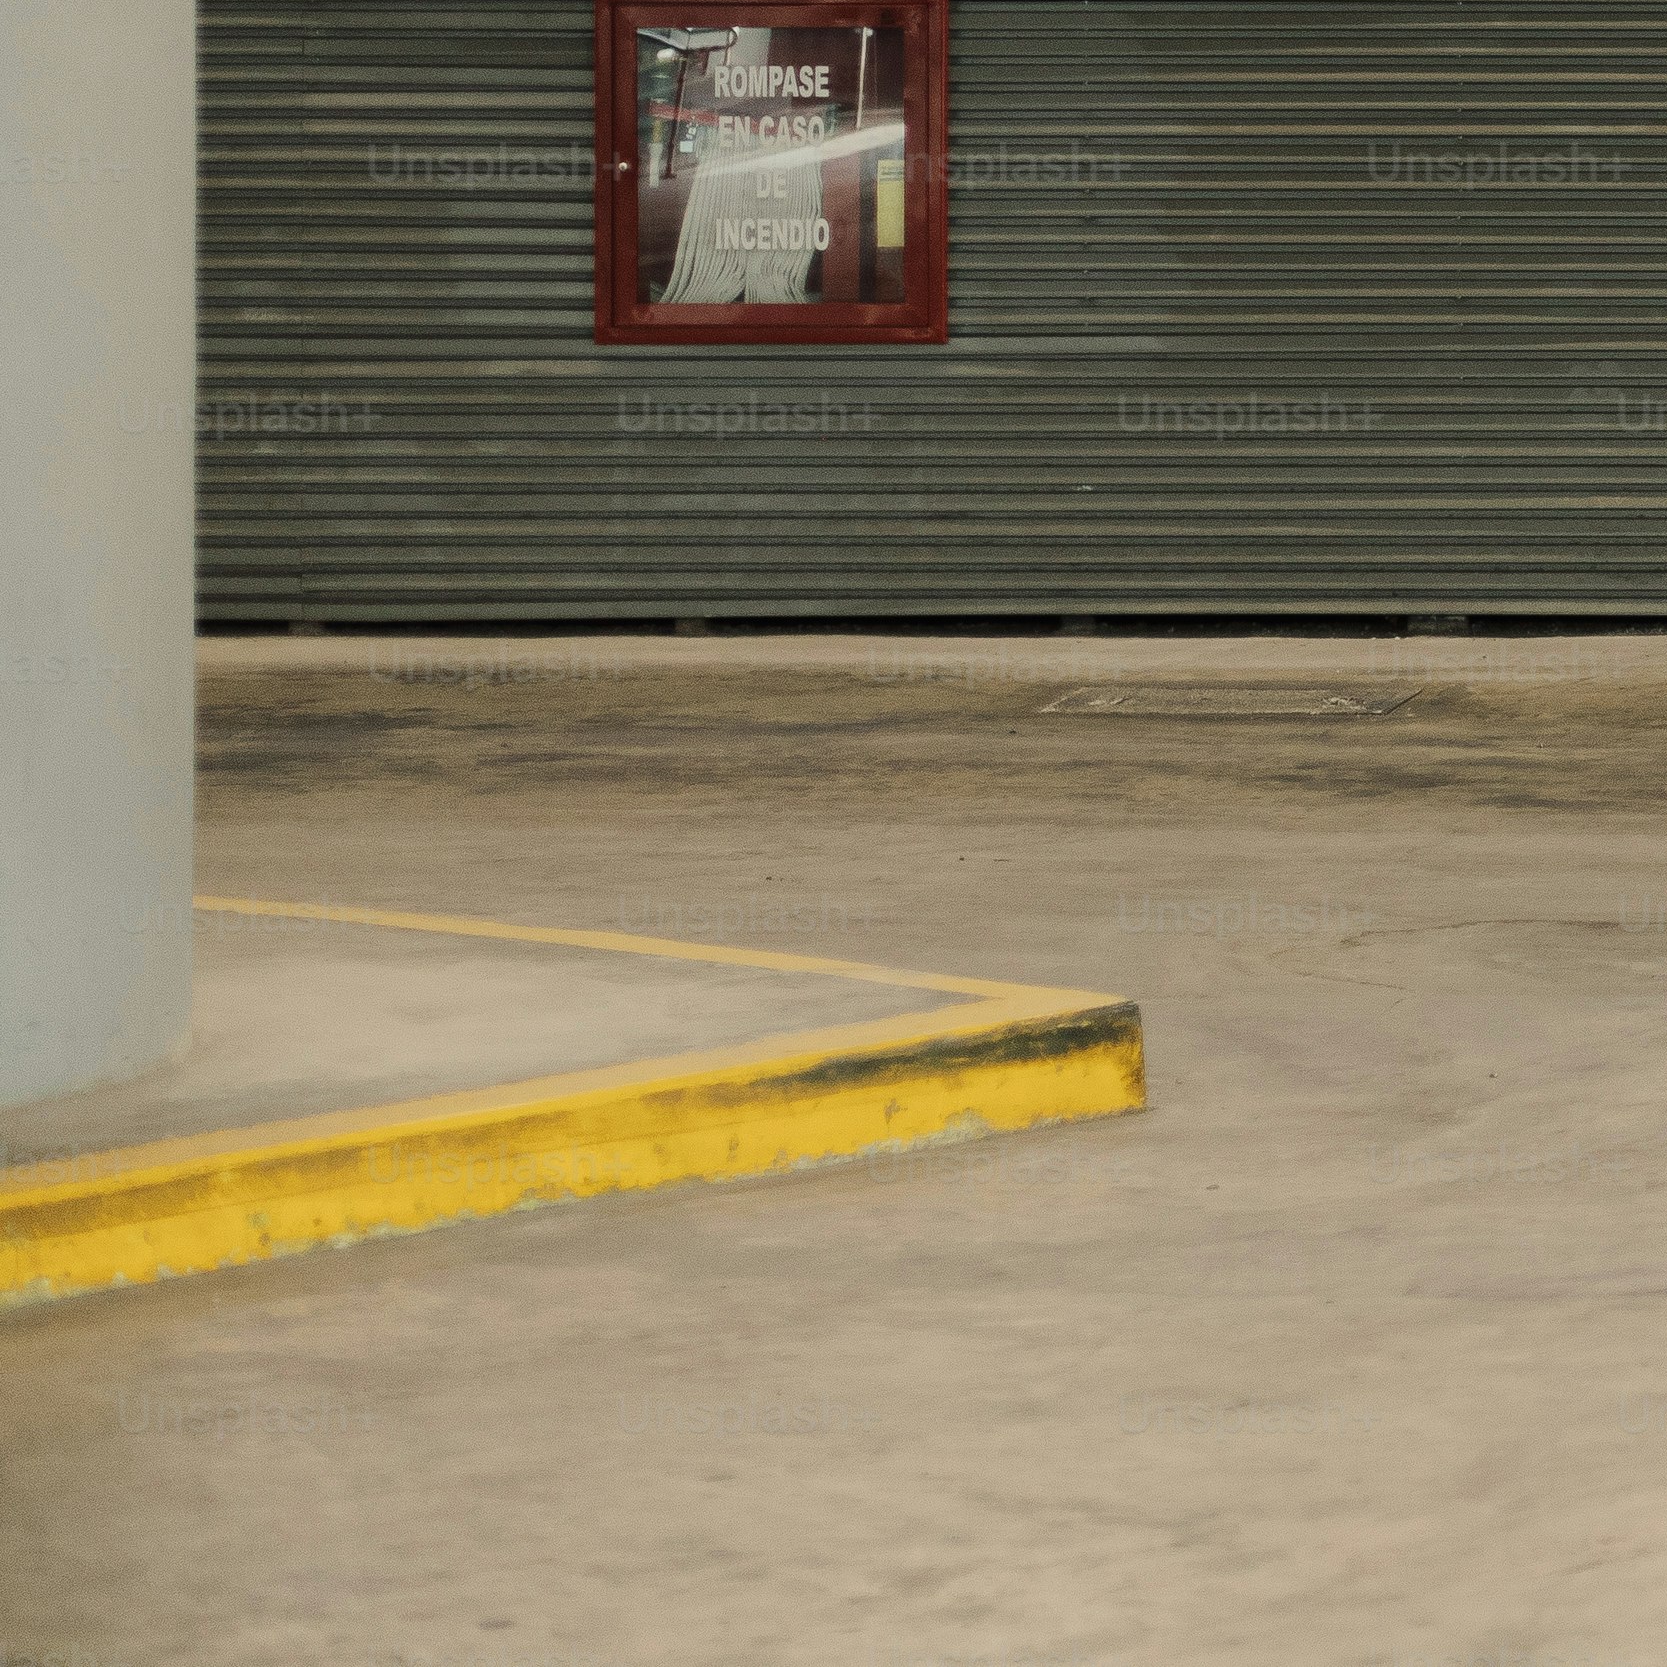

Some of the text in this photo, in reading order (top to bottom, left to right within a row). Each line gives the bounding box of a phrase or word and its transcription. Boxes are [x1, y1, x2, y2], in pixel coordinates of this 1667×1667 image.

[713, 64, 830, 99] ROMPASE
[717, 114, 825, 148] EN CASO
[755, 168, 788, 200] DE
[715, 217, 831, 252] INCENDIO
